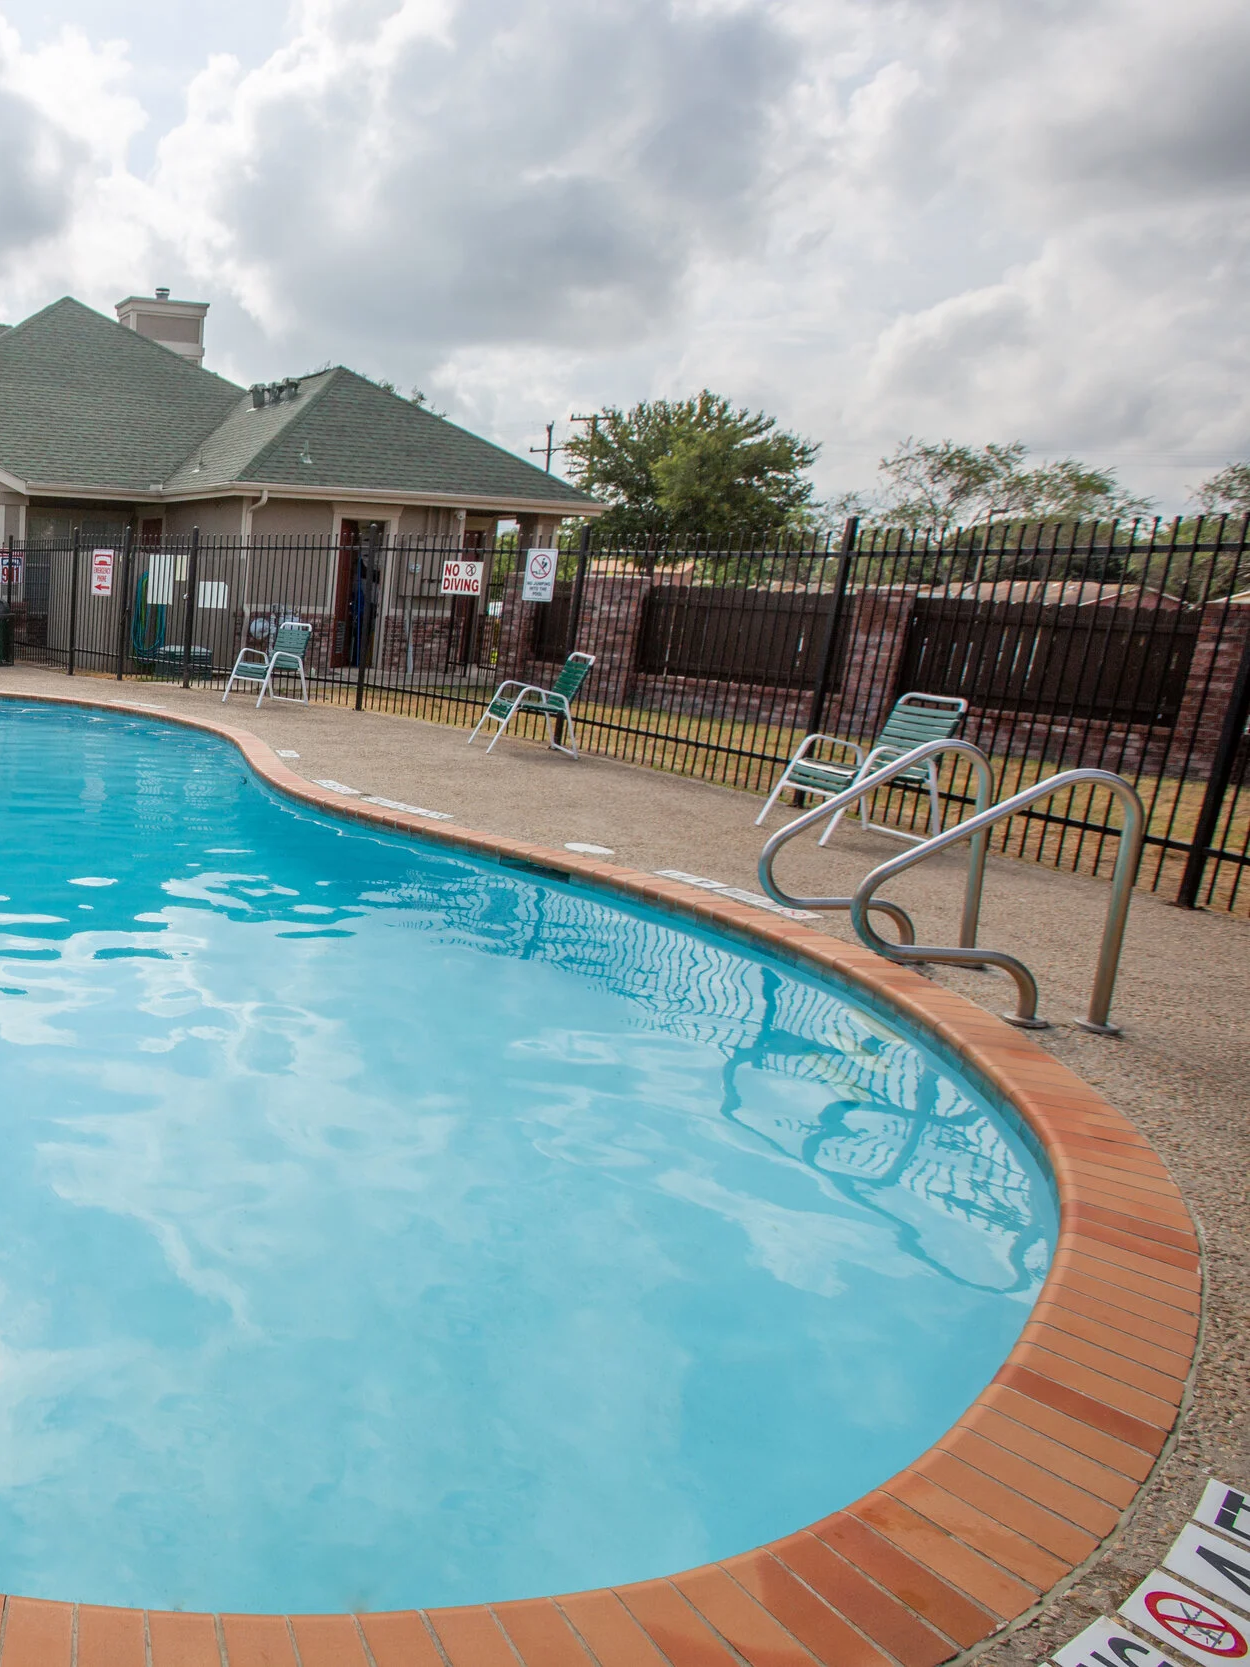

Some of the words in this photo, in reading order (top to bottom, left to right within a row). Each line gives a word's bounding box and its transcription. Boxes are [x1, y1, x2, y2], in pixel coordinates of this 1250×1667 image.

[2, 566, 19, 583] 911
[444, 564, 459, 577] NO
[443, 578, 479, 592] DIVING
